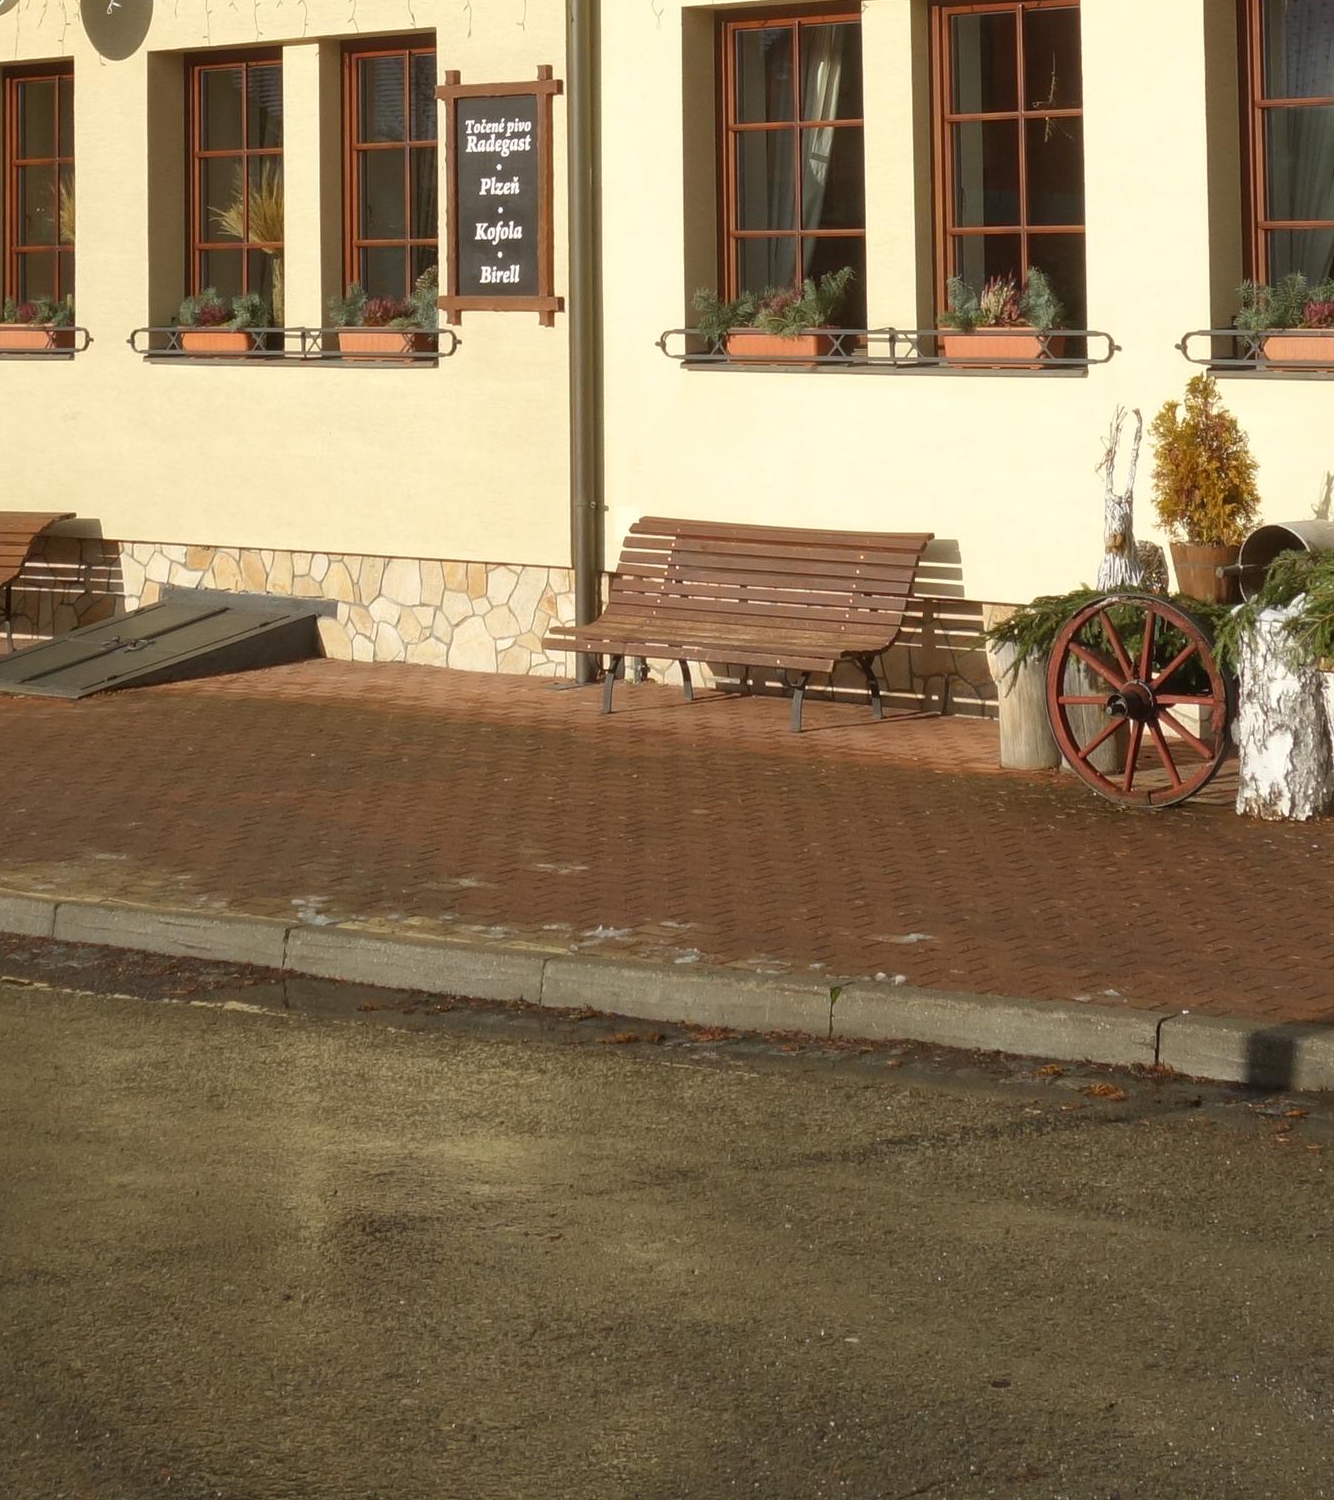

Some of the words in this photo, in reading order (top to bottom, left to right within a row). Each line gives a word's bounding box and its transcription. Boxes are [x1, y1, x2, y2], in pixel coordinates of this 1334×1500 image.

[465, 118, 505, 135] Točené
[506, 119, 532, 137] pivo
[465, 135, 532, 157] Radegast
[479, 177, 520, 196] Plzeň
[474, 221, 523, 246] Kofola
[479, 265, 520, 284] Birell
